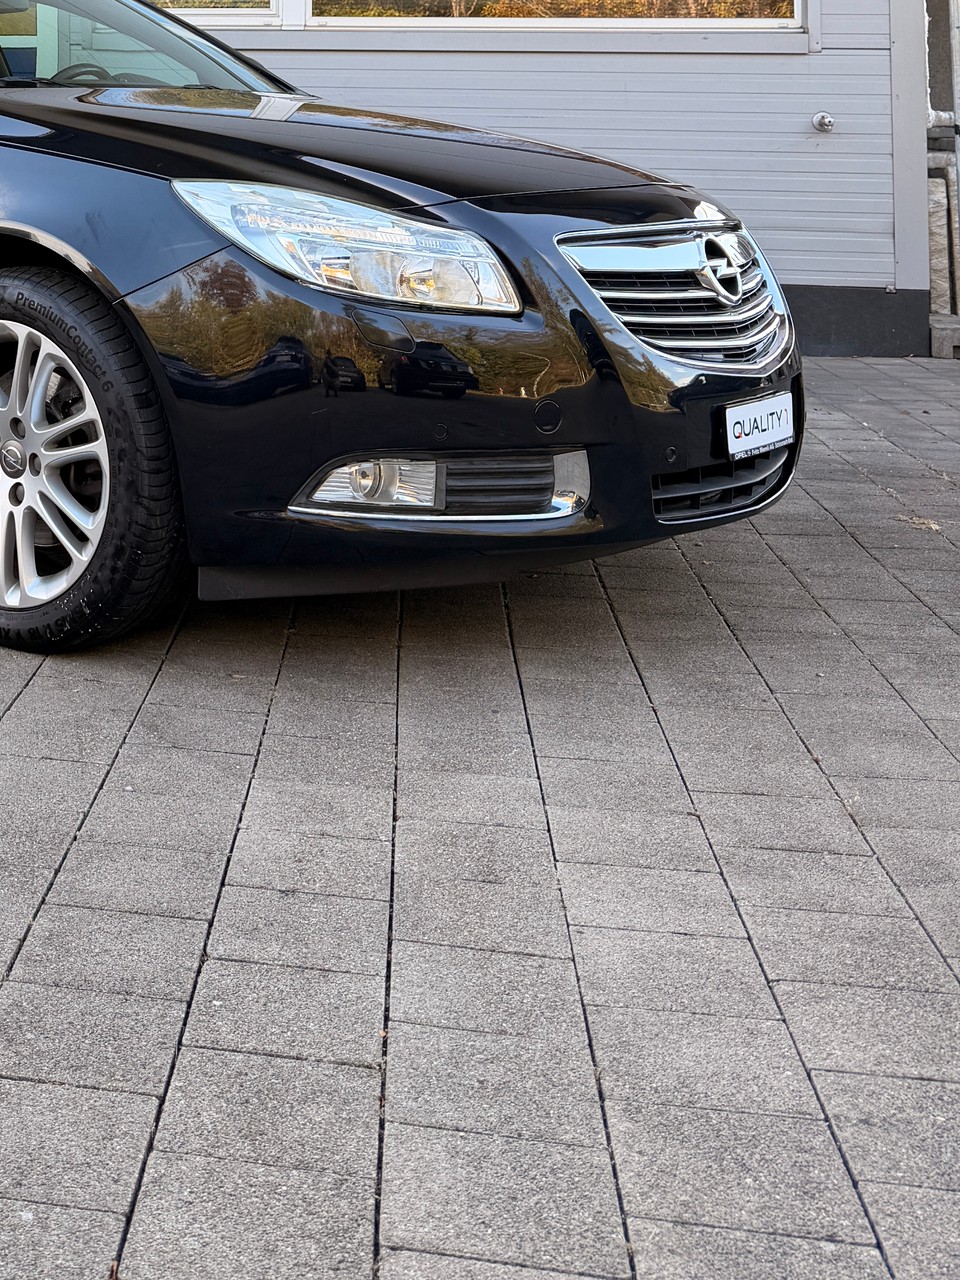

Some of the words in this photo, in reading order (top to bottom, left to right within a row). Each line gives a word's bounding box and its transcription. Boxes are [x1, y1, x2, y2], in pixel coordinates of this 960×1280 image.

[15, 291, 107, 382] PremiumContact
[101, 380, 114, 393] 6
[734, 451, 748, 460] OPEL
